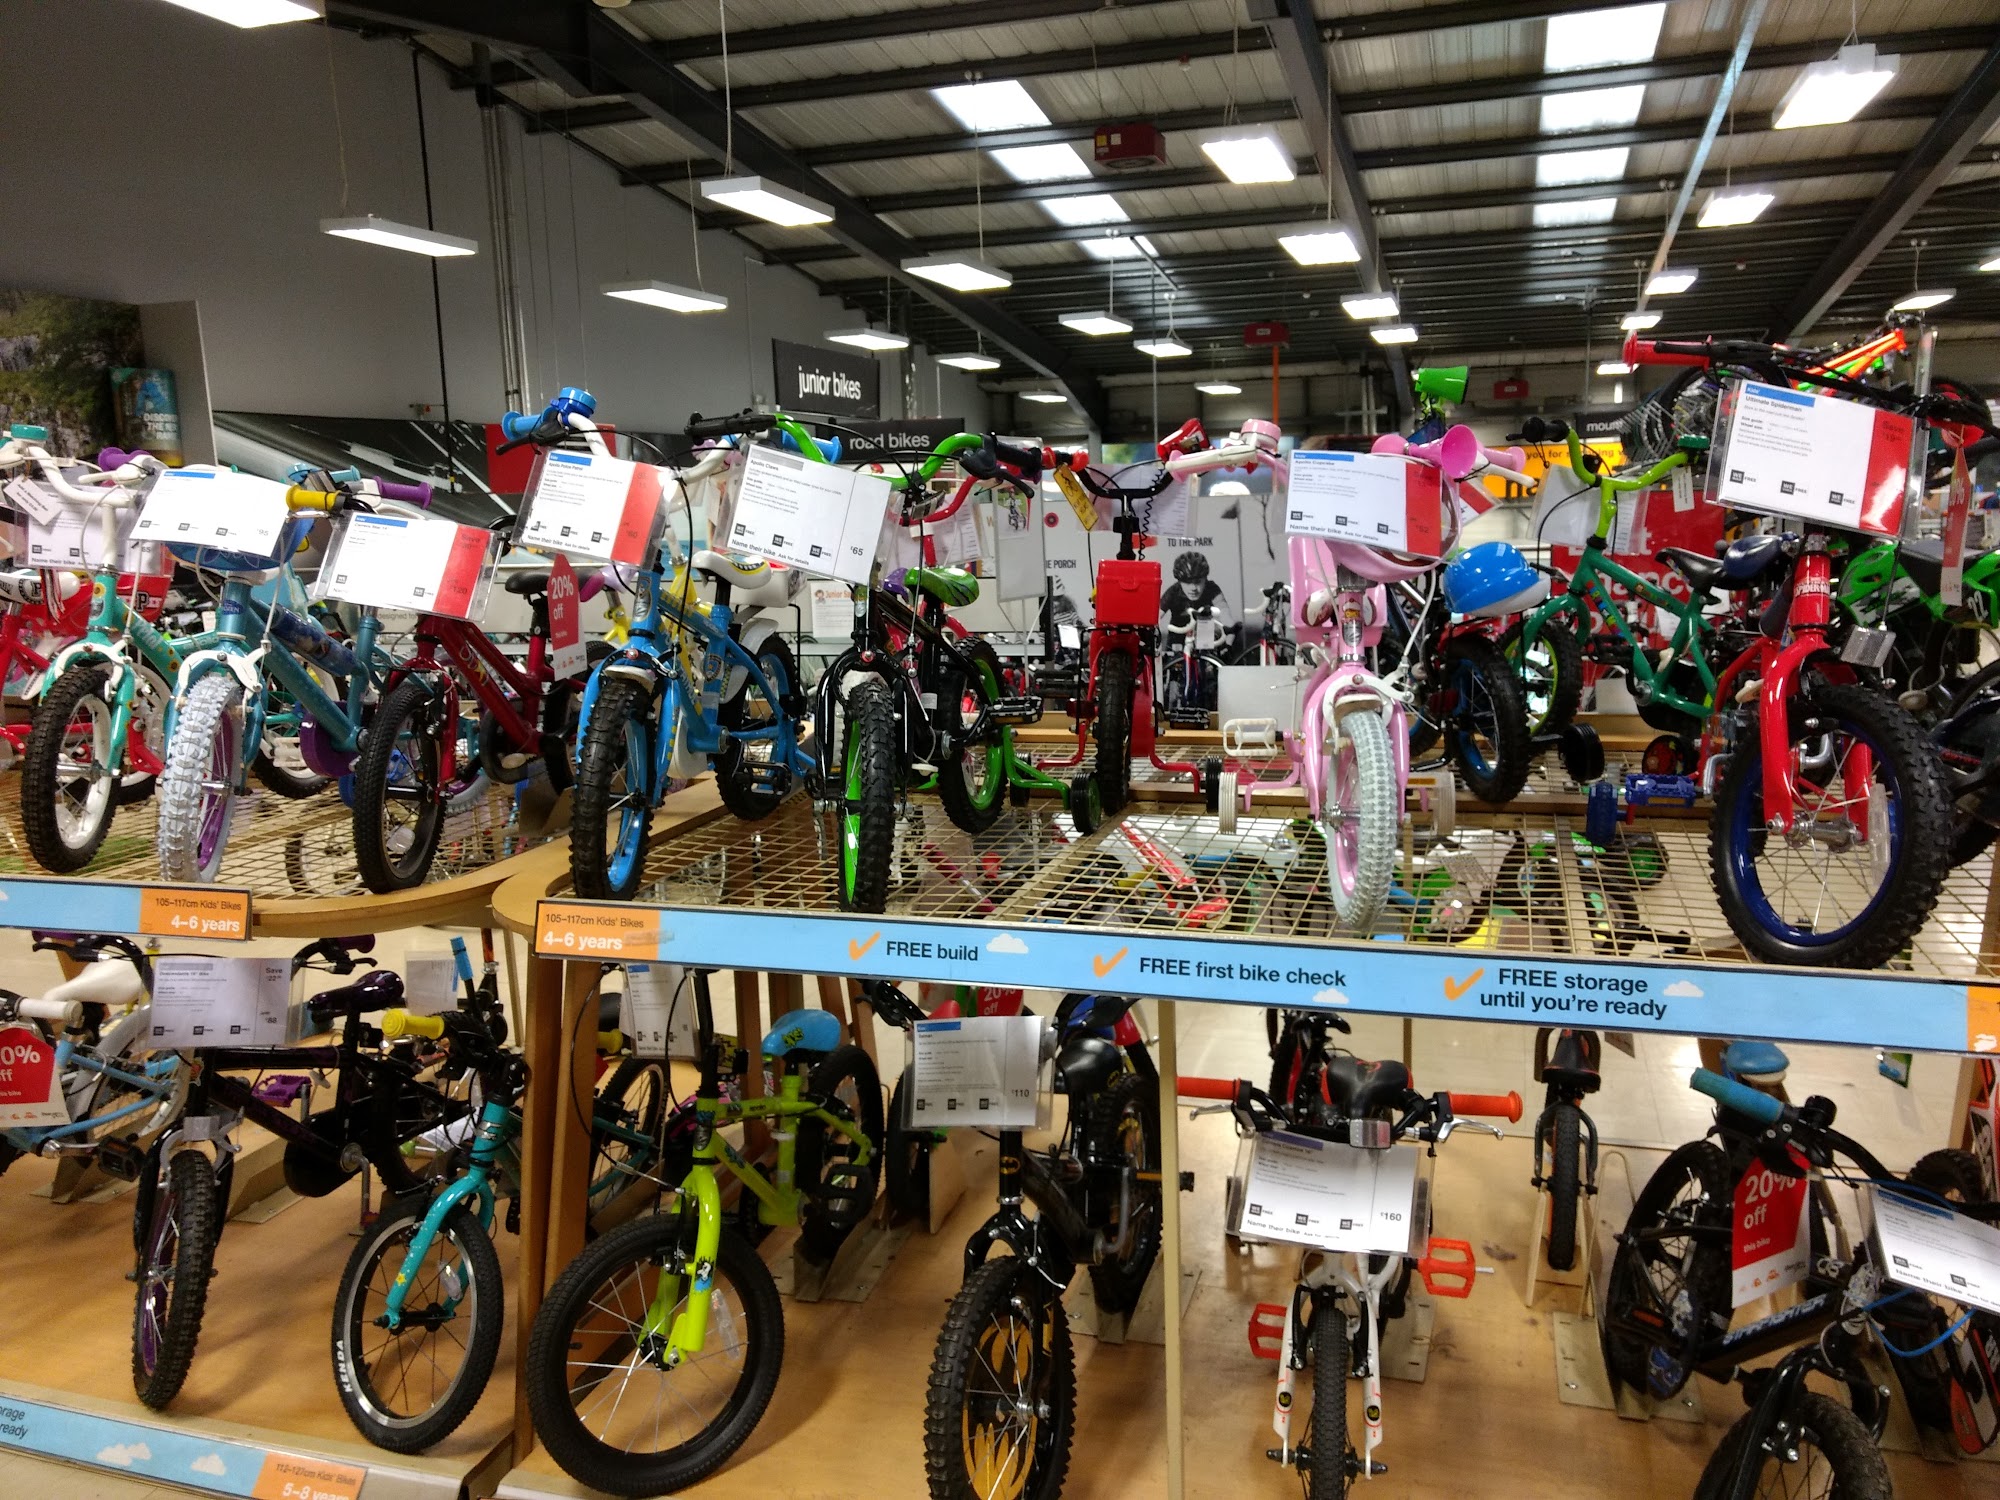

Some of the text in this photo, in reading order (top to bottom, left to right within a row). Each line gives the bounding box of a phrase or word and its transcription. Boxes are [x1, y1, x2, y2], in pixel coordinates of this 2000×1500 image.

[798, 366, 861, 400] junior bikes
[1745, 395, 1802, 414] Ultimate Spiderman
[850, 433, 930, 450] road bikes
[1549, 450, 1562, 458] for
[750, 459, 779, 471] Apollo Claws
[1289, 522, 1308, 531] Name
[1310, 525, 1326, 533] their
[1168, 536, 1213, 547] TO THE PARK
[731, 539, 748, 548] Name
[748, 543, 762, 552] their
[763, 547, 775, 555] bike
[794, 557, 809, 565] details
[1054, 559, 1076, 568] PORCH
[551, 575, 574, 599] 20%
[553, 607, 563, 620] off
[200, 900, 219, 909] Kids'
[221, 901, 242, 911] Bikes
[171, 915, 241, 933] 4-6 years
[545, 913, 644, 928] 105-117cm Kids' Bikes
[543, 930, 622, 950] 4-6 years
[886, 940, 978, 961] FREE build
[1140, 957, 1346, 986] FREE first bike check
[1498, 968, 1647, 995] FREE storage
[984, 1002, 998, 1016] off
[1480, 990, 1668, 1020] until you're ready
[0, 1069, 12, 1081] ff
[1011, 1089, 1029, 1097] £110
[1746, 1170, 1796, 1204] 20%
[1246, 1219, 1266, 1228] Name
[1380, 1211, 1402, 1222] £160
[1744, 1205, 1767, 1230] off
[1744, 1238, 1770, 1253] this bike
[336, 1340, 353, 1392] KENDA
[0, 1424, 28, 1439] ready
[312, 1490, 349, 1500] years
